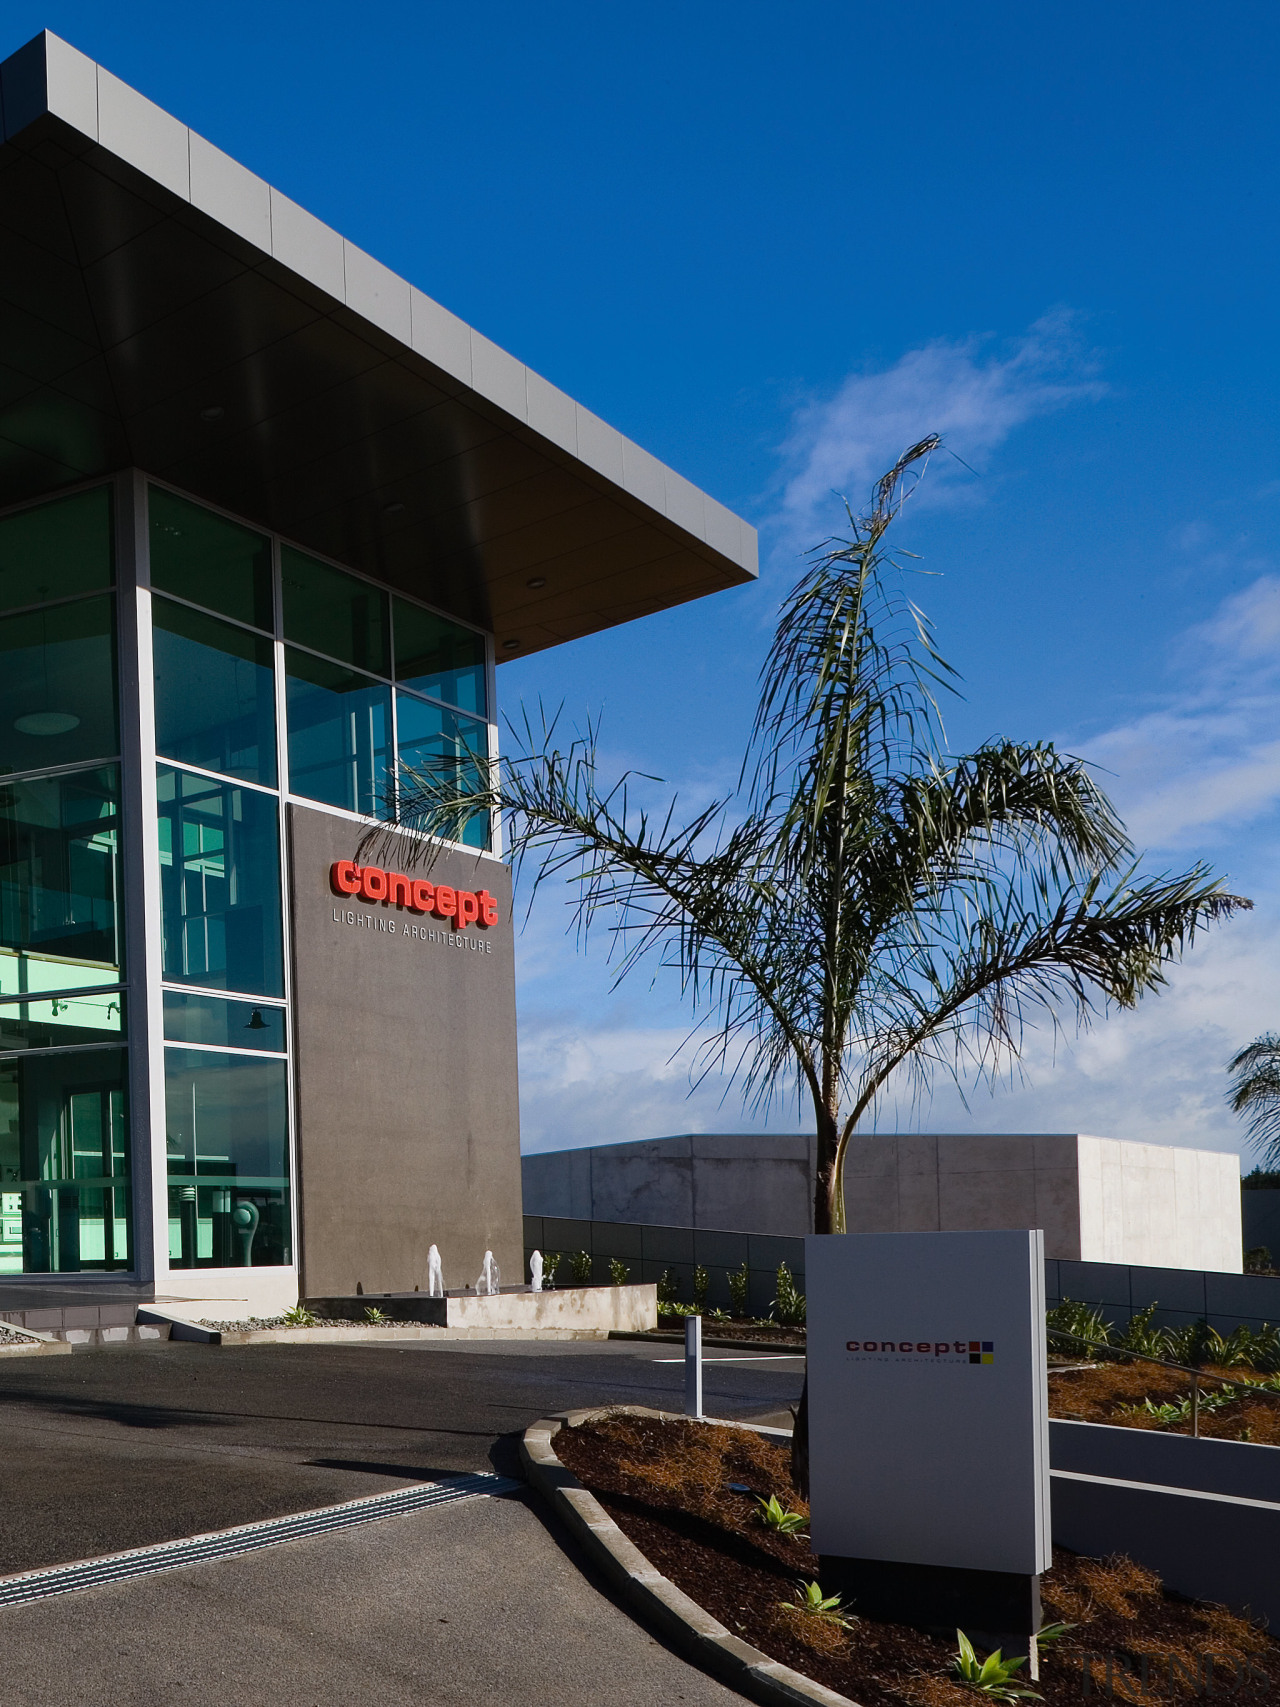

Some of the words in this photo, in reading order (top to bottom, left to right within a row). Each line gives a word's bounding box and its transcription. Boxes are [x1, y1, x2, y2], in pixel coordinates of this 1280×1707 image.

[331, 860, 498, 929] concept
[332, 908, 396, 933] LIGHTING
[402, 923, 492, 954] ARCHITECTURE
[846, 1341, 967, 1356] concept
